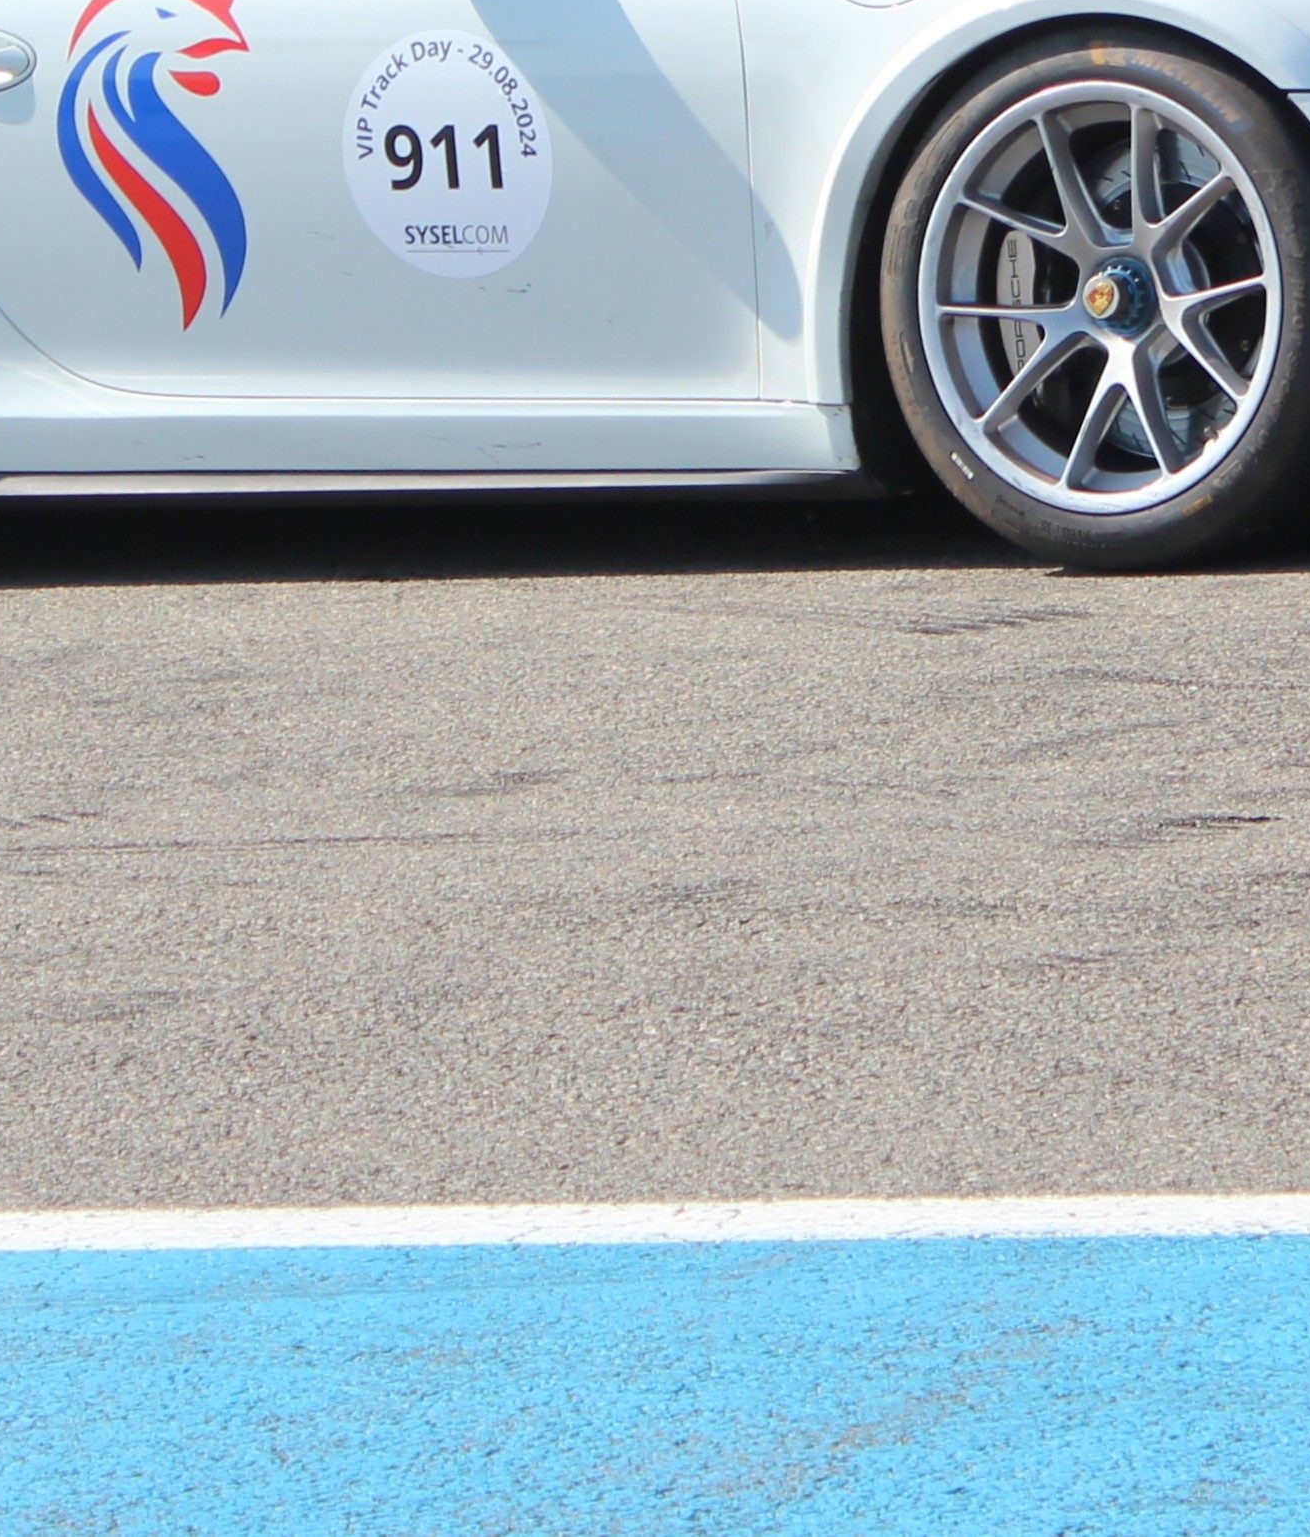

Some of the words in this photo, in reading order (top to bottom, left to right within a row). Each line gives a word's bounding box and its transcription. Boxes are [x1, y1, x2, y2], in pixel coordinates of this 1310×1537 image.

[410, 39, 452, 63] Day
[360, 53, 409, 111] Track
[467, 44, 538, 159] 29.08.2024
[356, 117, 374, 160] VIP
[383, 123, 505, 191] 911
[404, 225, 510, 245] SYSELCOM
